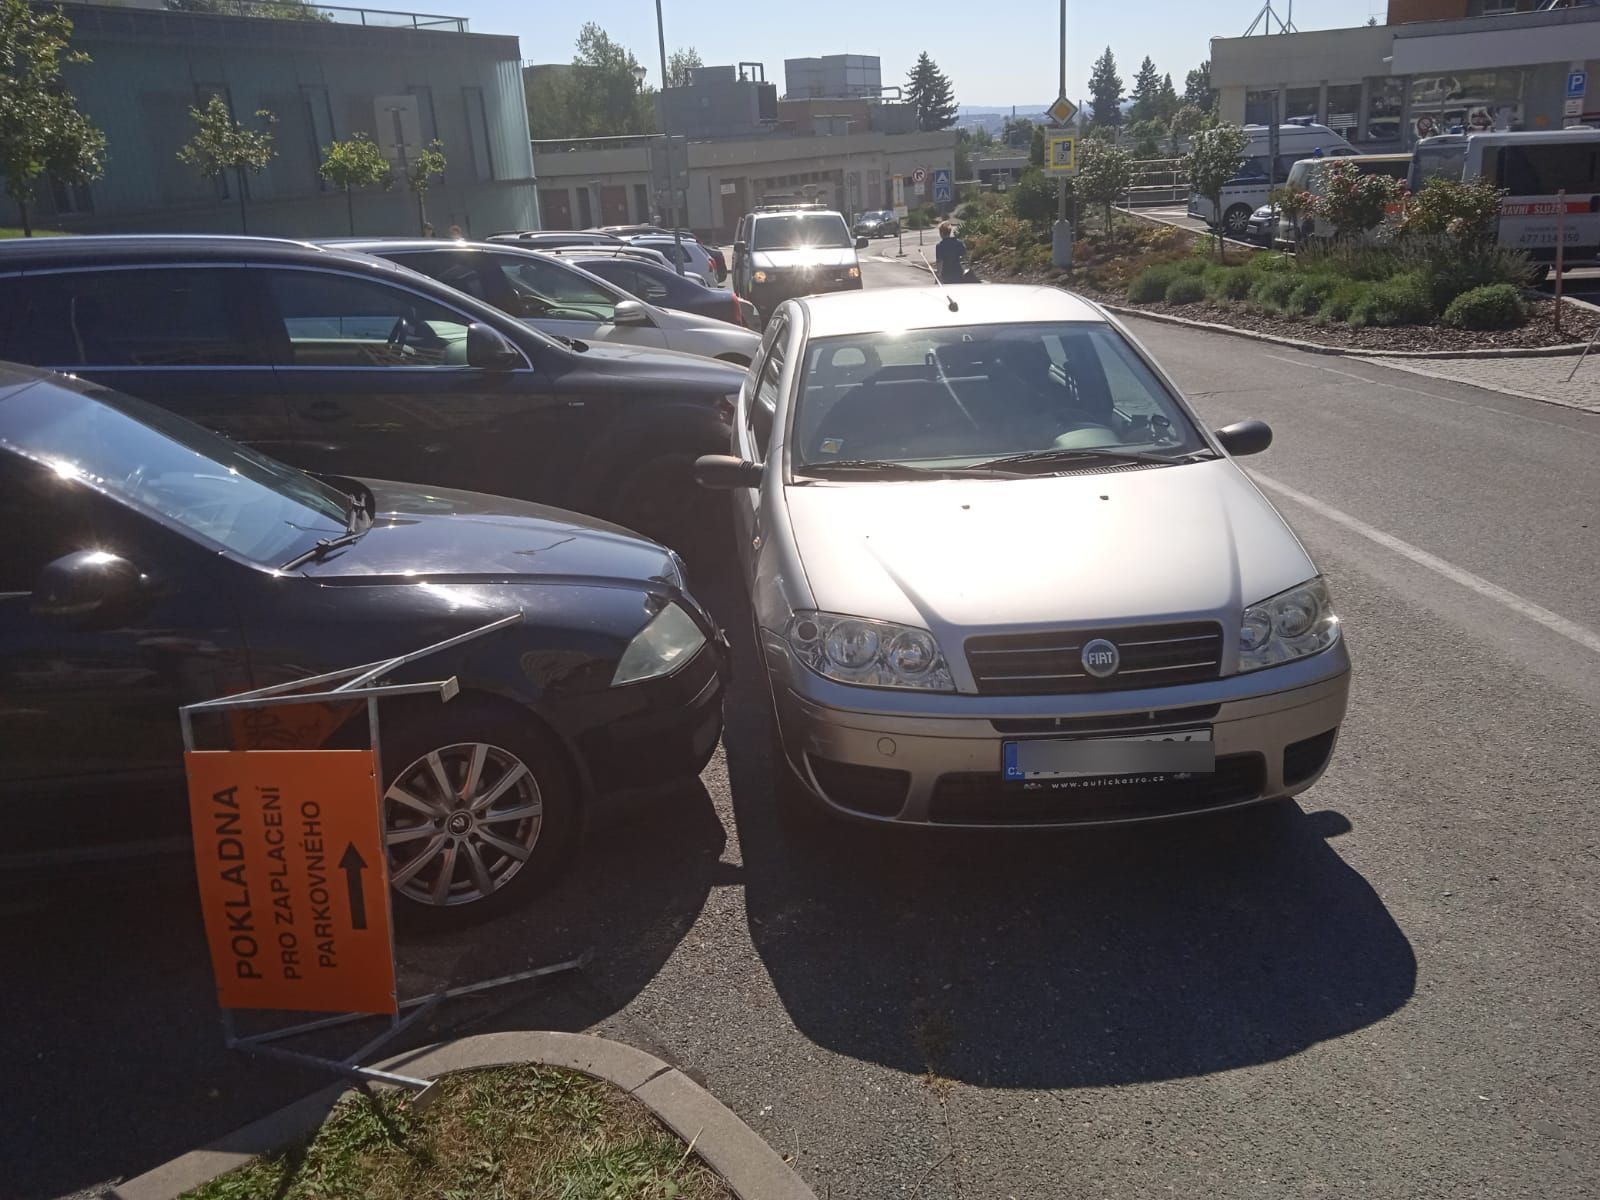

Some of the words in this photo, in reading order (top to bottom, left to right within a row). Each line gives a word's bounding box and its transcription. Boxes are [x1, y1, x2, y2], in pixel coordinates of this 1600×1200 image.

[1571, 75, 1583, 90] P
[1089, 651, 1113, 665] FIAT
[212, 785, 262, 980] POKLADNA
[256, 786, 294, 925] ZAPLACENÍ
[298, 801, 337, 968] PARKOVNÉHO
[278, 932, 302, 980] PRO
